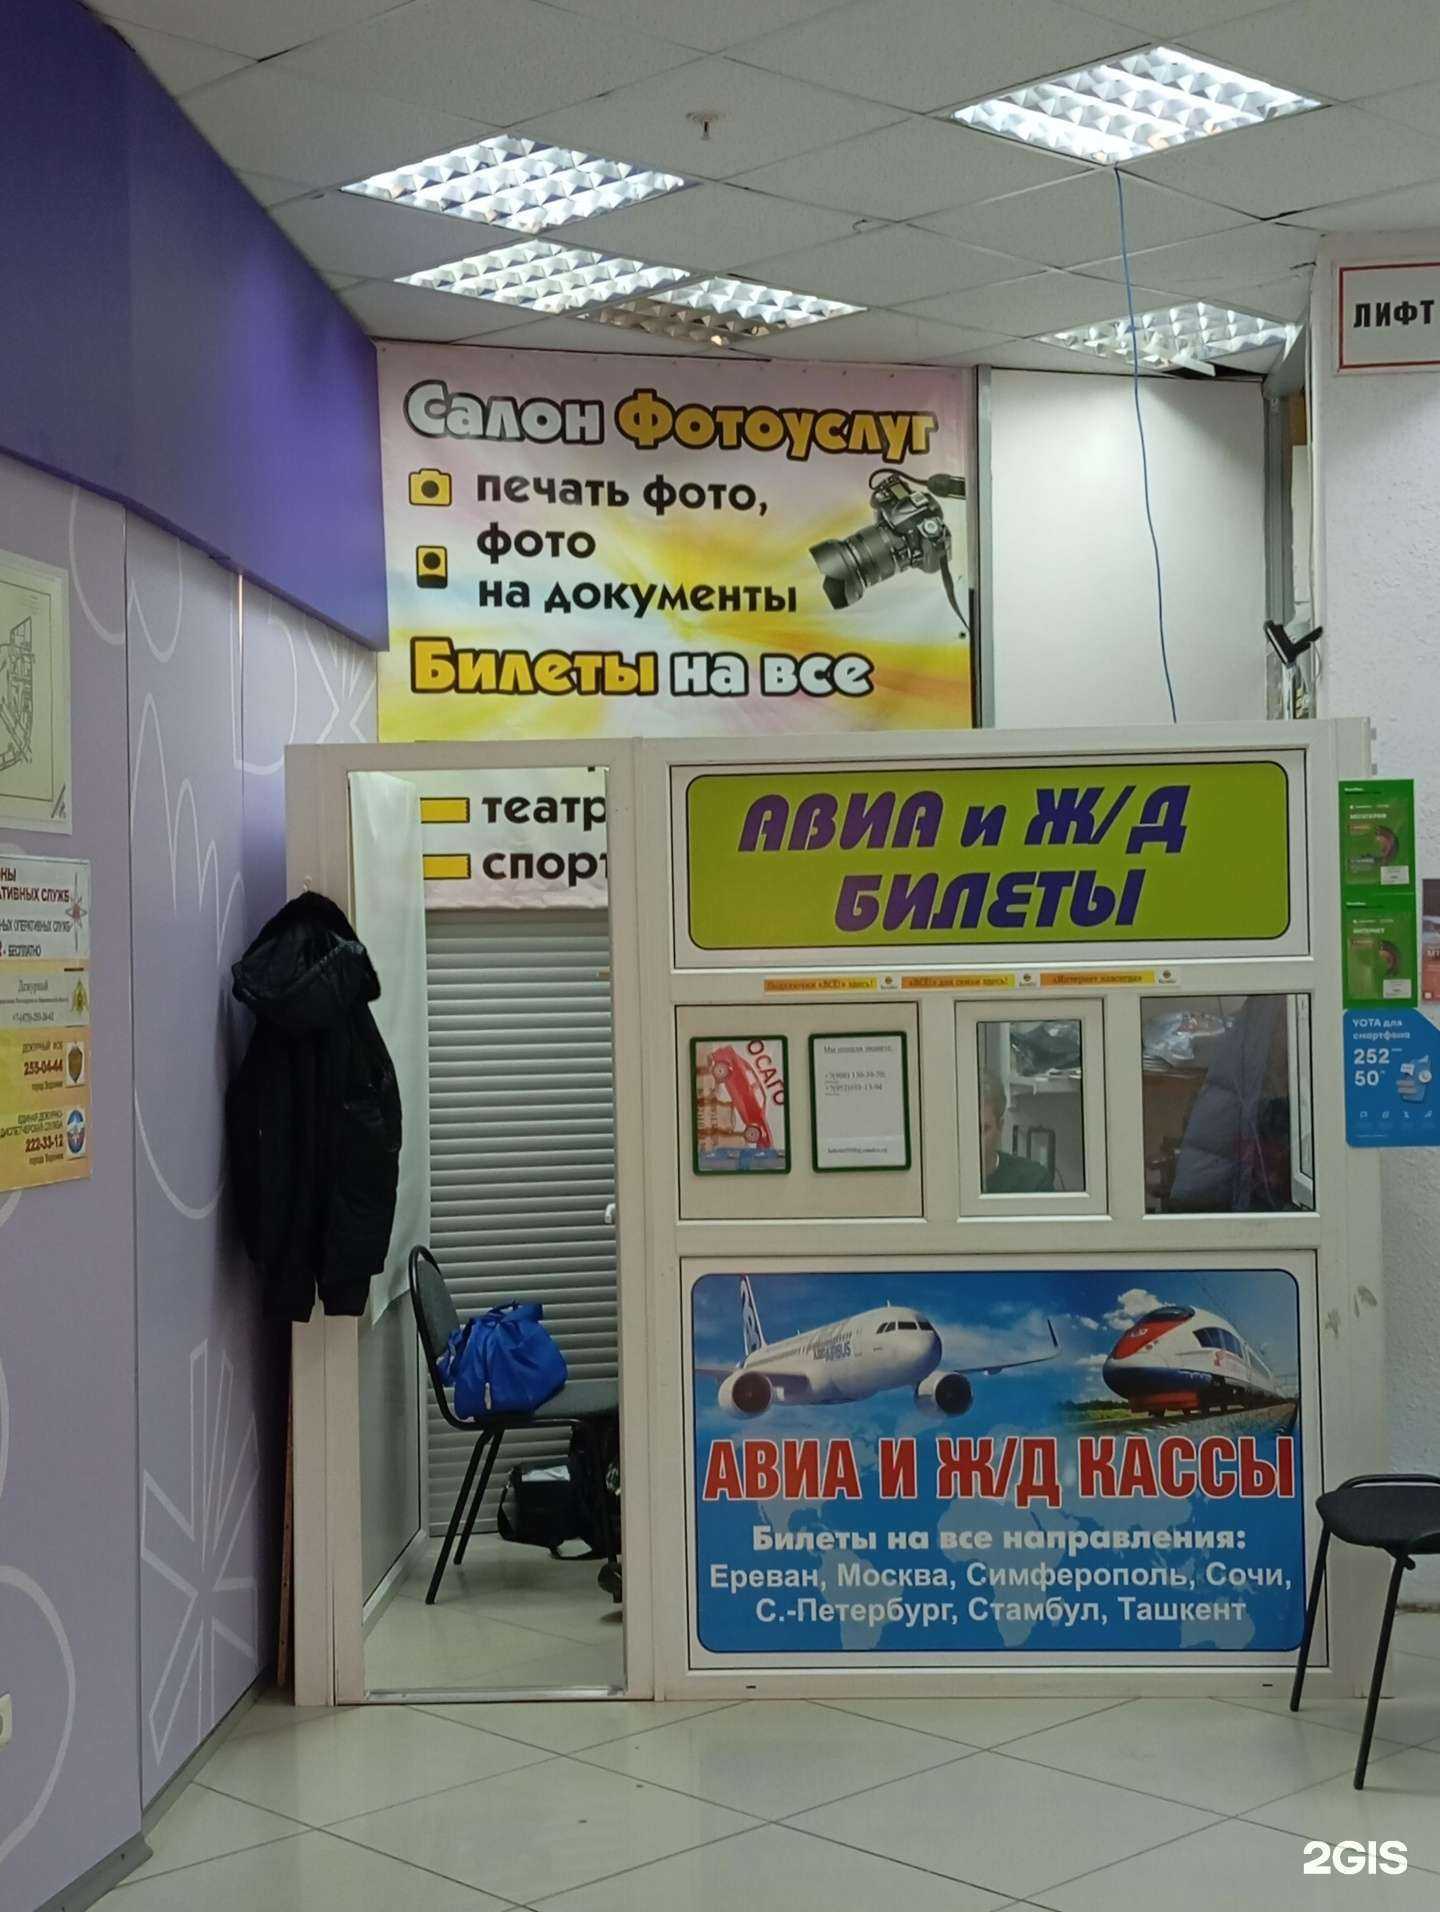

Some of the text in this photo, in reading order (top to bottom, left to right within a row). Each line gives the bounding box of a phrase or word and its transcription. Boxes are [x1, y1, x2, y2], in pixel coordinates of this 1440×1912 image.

[1353, 299, 1434, 328] ЛИФТ
[403, 380, 937, 462] Салон Фотоуслуг
[477, 474, 768, 516] печать фото,
[477, 522, 596, 564] фото
[478, 581, 797, 617] на документы
[410, 636, 874, 697] Билеты на все
[737, 785, 1191, 855] АВИА и Ж/Д
[834, 869, 1146, 932] БИЛЕТЫ
[1353, 1048, 1390, 1065] 252
[1354, 1070, 1379, 1086] 50
[702, 1436, 1295, 1508] АВИА И Ж/Д КАССЫ
[753, 1525, 1246, 1556] Билеты на все направления:
[710, 1562, 1292, 1592] Ереван, Москва, Симферополь, Сочи,
[756, 1597, 1247, 1627] С.-Петербург, Стамбул, Ташкент
